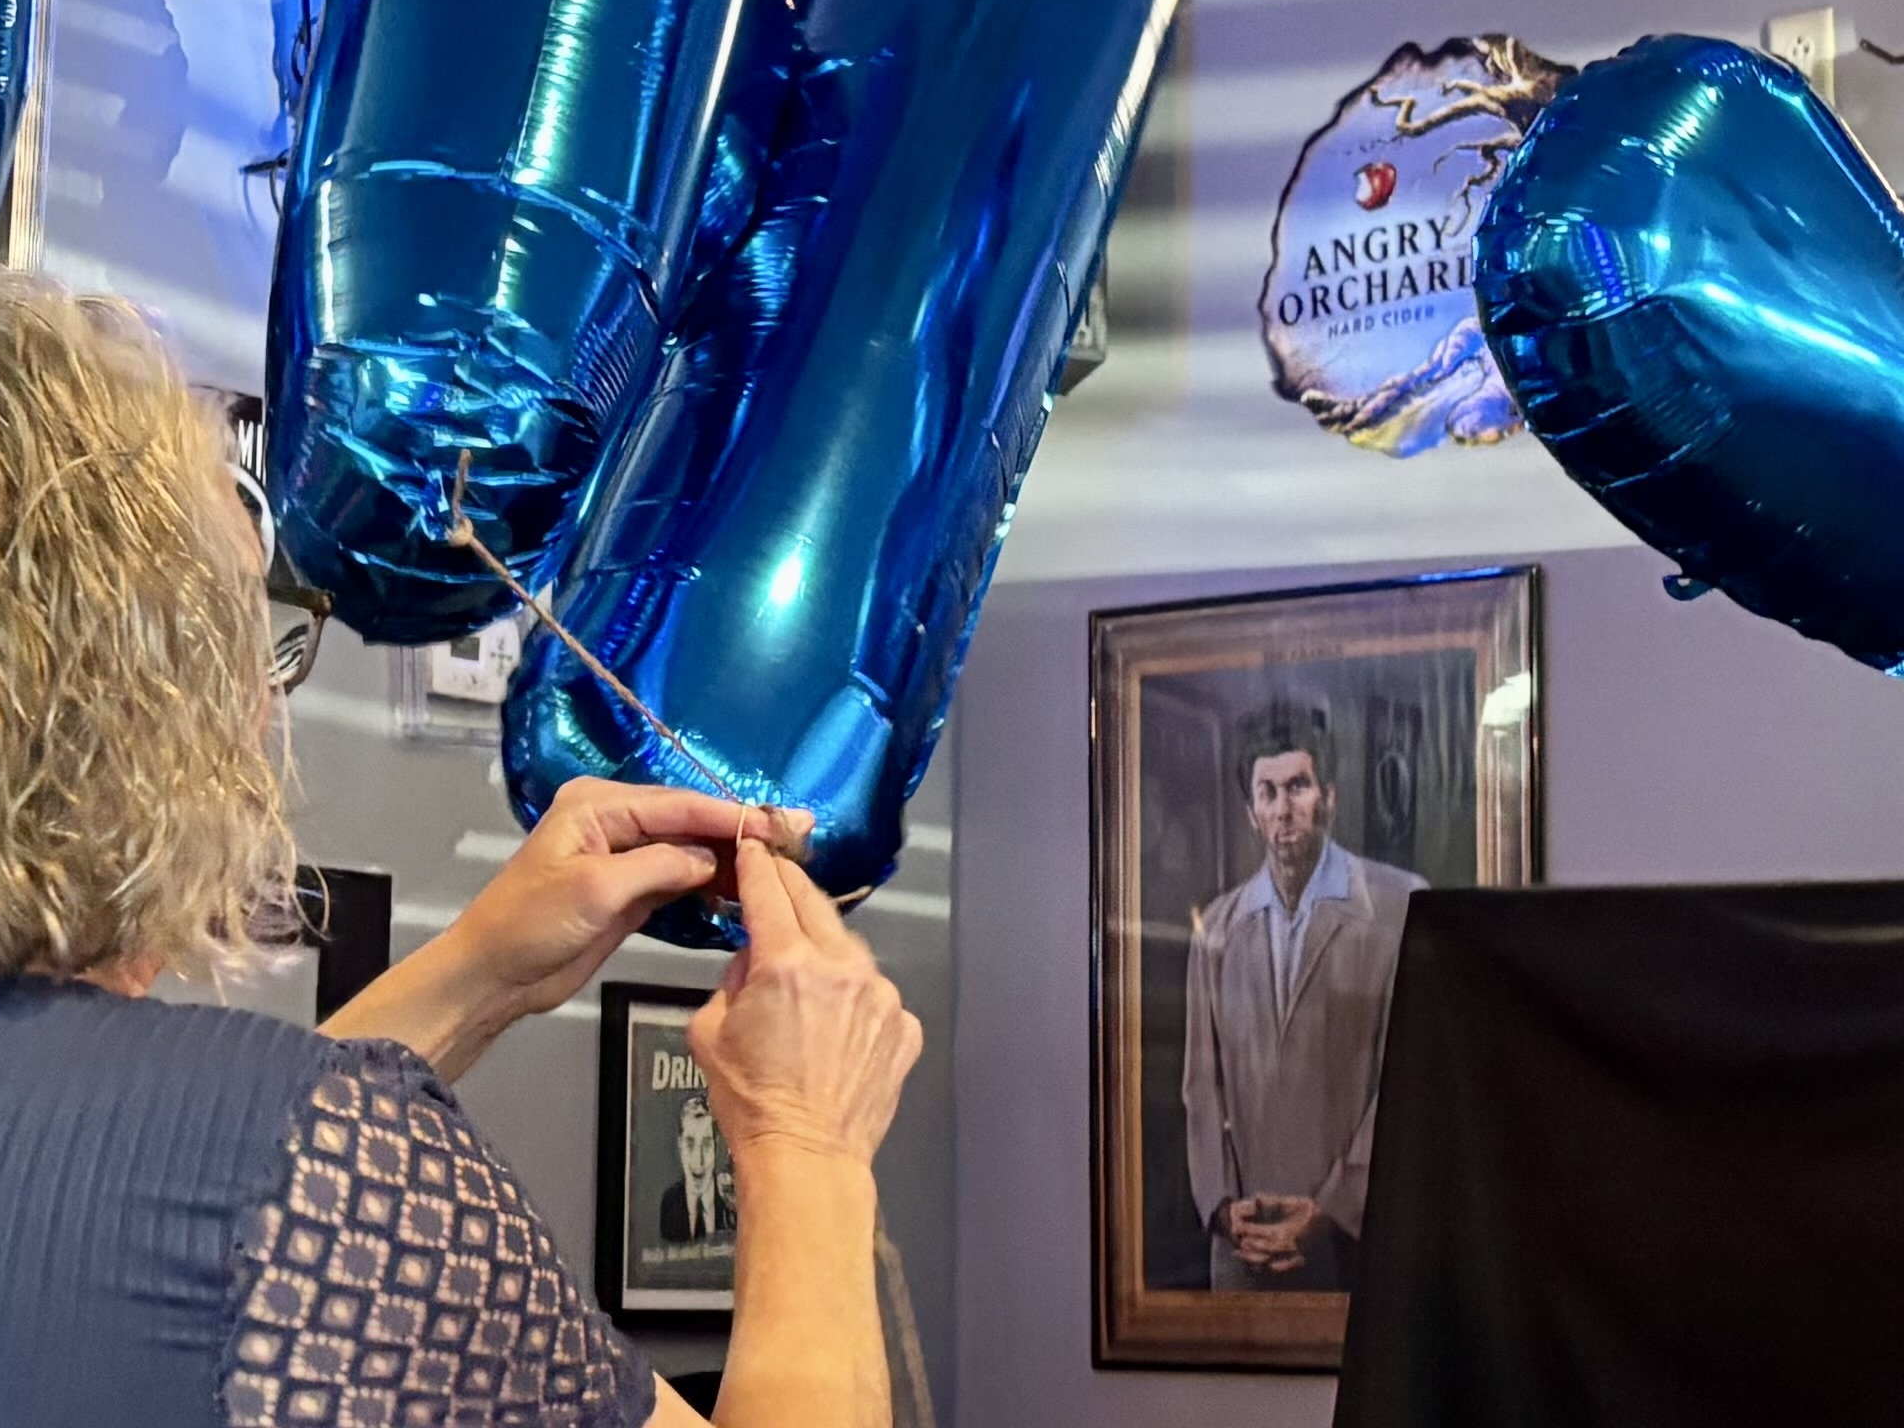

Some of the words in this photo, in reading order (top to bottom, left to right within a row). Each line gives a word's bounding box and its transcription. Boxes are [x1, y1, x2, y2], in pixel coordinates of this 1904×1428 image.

[1303, 215, 1452, 281] ANGRY
[1328, 314, 1376, 340] HARD
[1384, 304, 1435, 328] CIDER
[652, 1050, 708, 1092] DRIN
